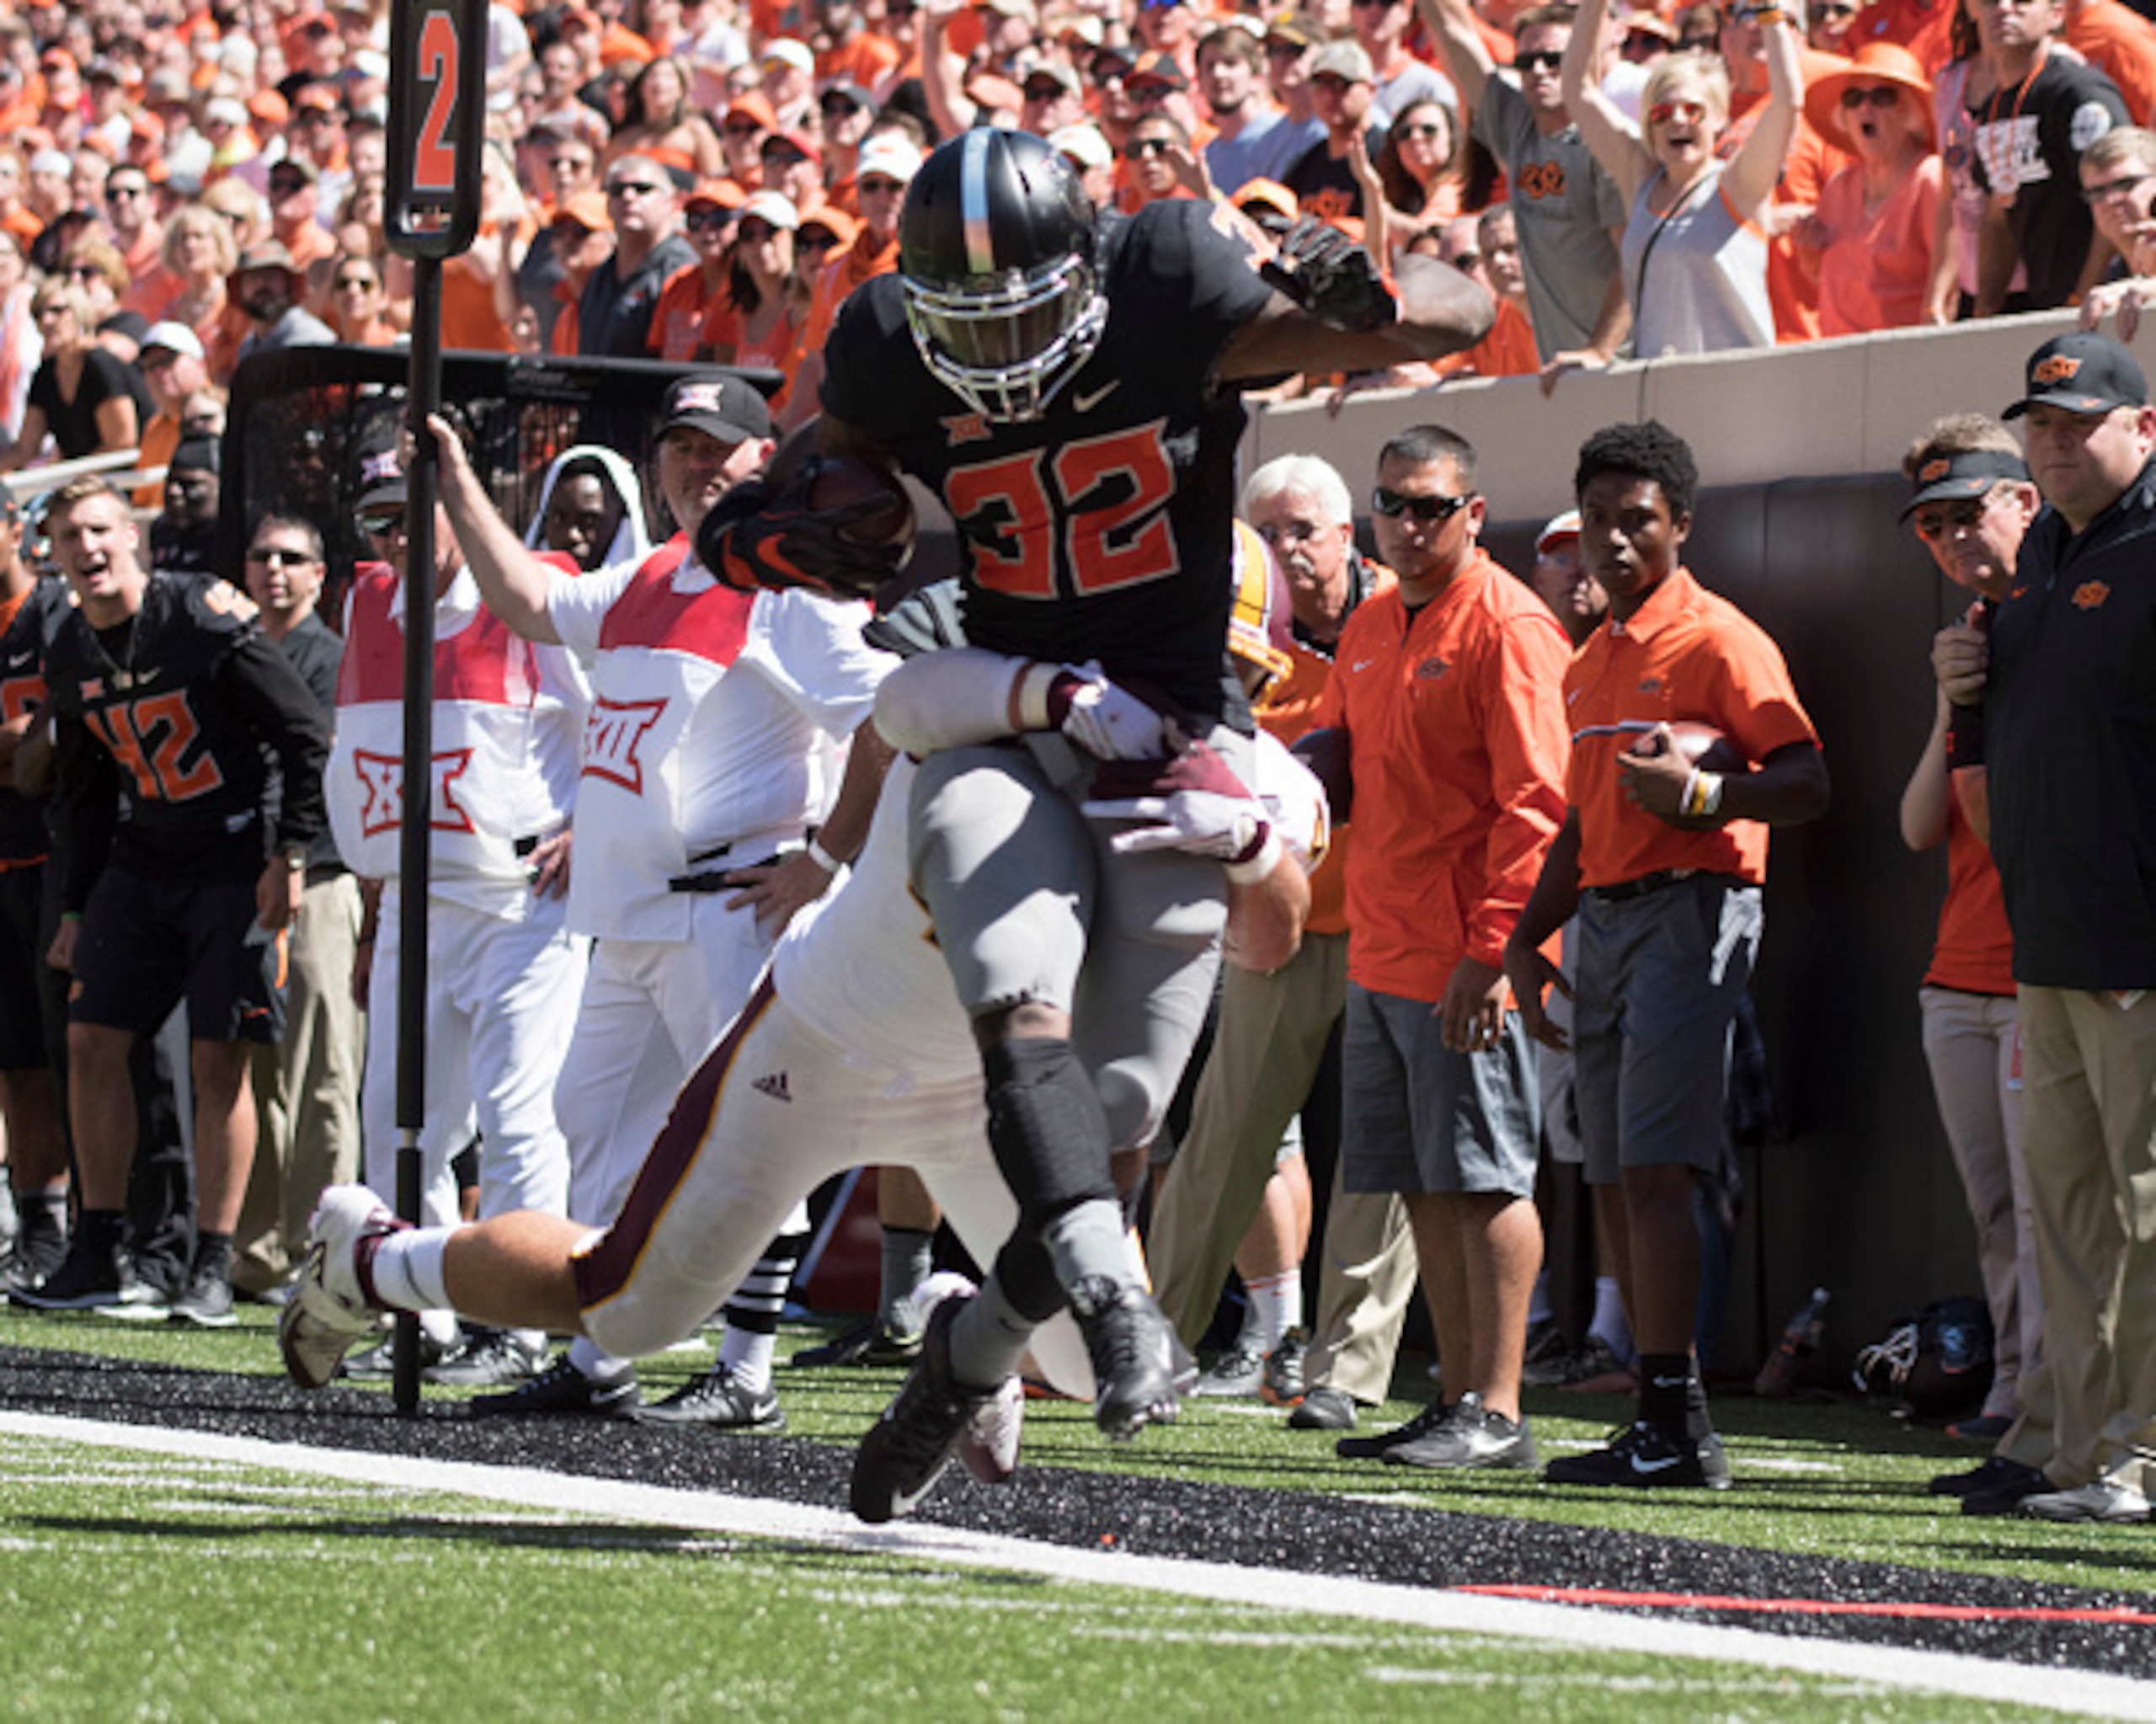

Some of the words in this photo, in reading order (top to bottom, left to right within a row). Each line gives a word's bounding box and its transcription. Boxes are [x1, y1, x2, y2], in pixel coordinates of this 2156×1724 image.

[413, 9, 459, 193] 2
[942, 416, 1180, 600] 32
[83, 687, 224, 801] 42
